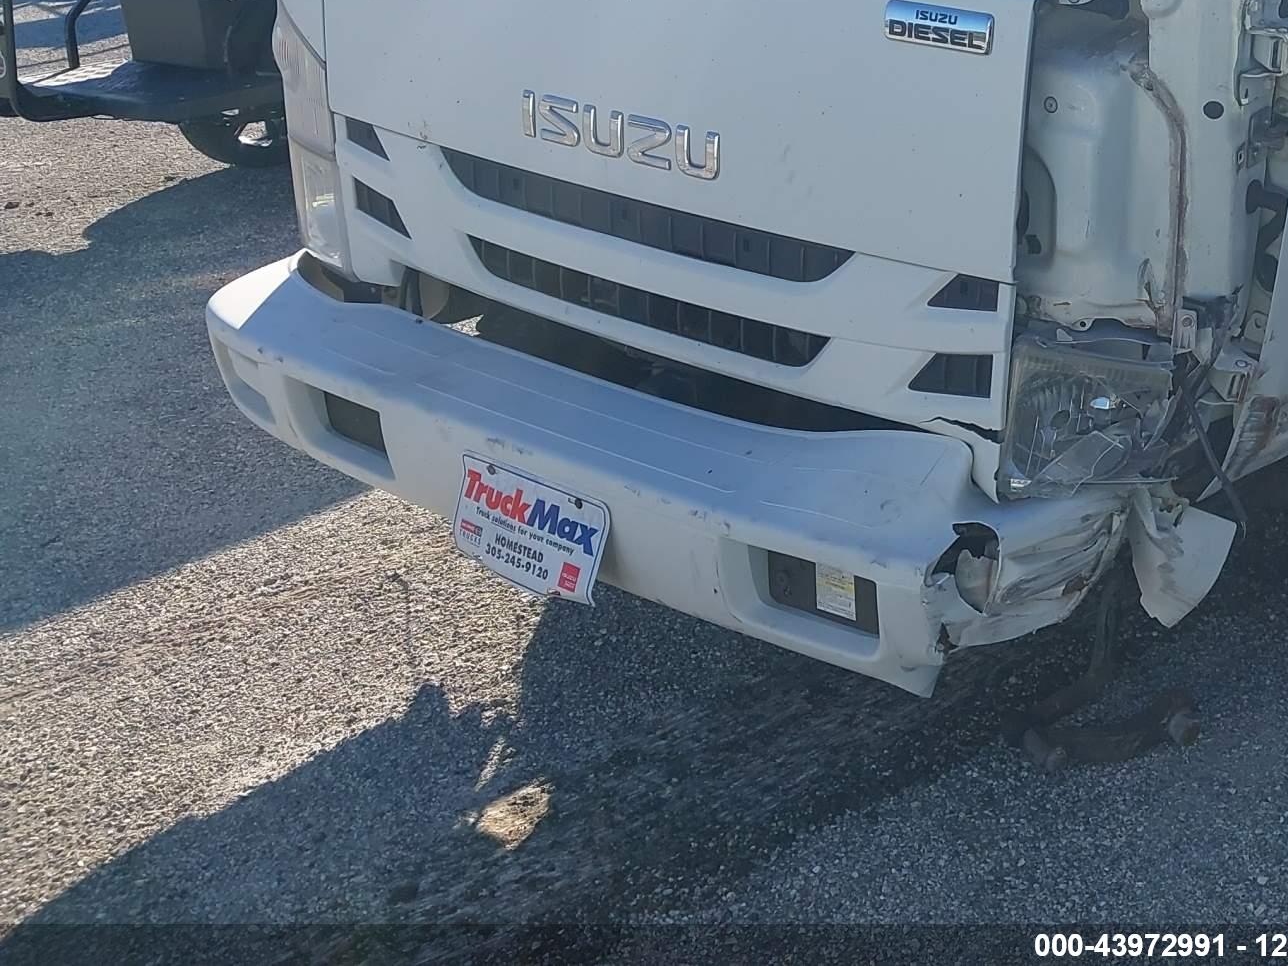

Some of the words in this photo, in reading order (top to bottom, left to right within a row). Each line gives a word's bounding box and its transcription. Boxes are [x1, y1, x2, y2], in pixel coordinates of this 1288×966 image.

[888, 19, 986, 51] DIESEL
[915, 9, 958, 26] ISUZU
[521, 89, 721, 181] ISUZU
[464, 468, 600, 557] TruckMax
[475, 506, 491, 522] Truck
[491, 514, 517, 534] solutions
[517, 525, 528, 536] for
[528, 529, 545, 544] your
[545, 538, 575, 556] company
[485, 543, 549, 581] 305-245-9120
[494, 533, 544, 563] HOMESTEAD
